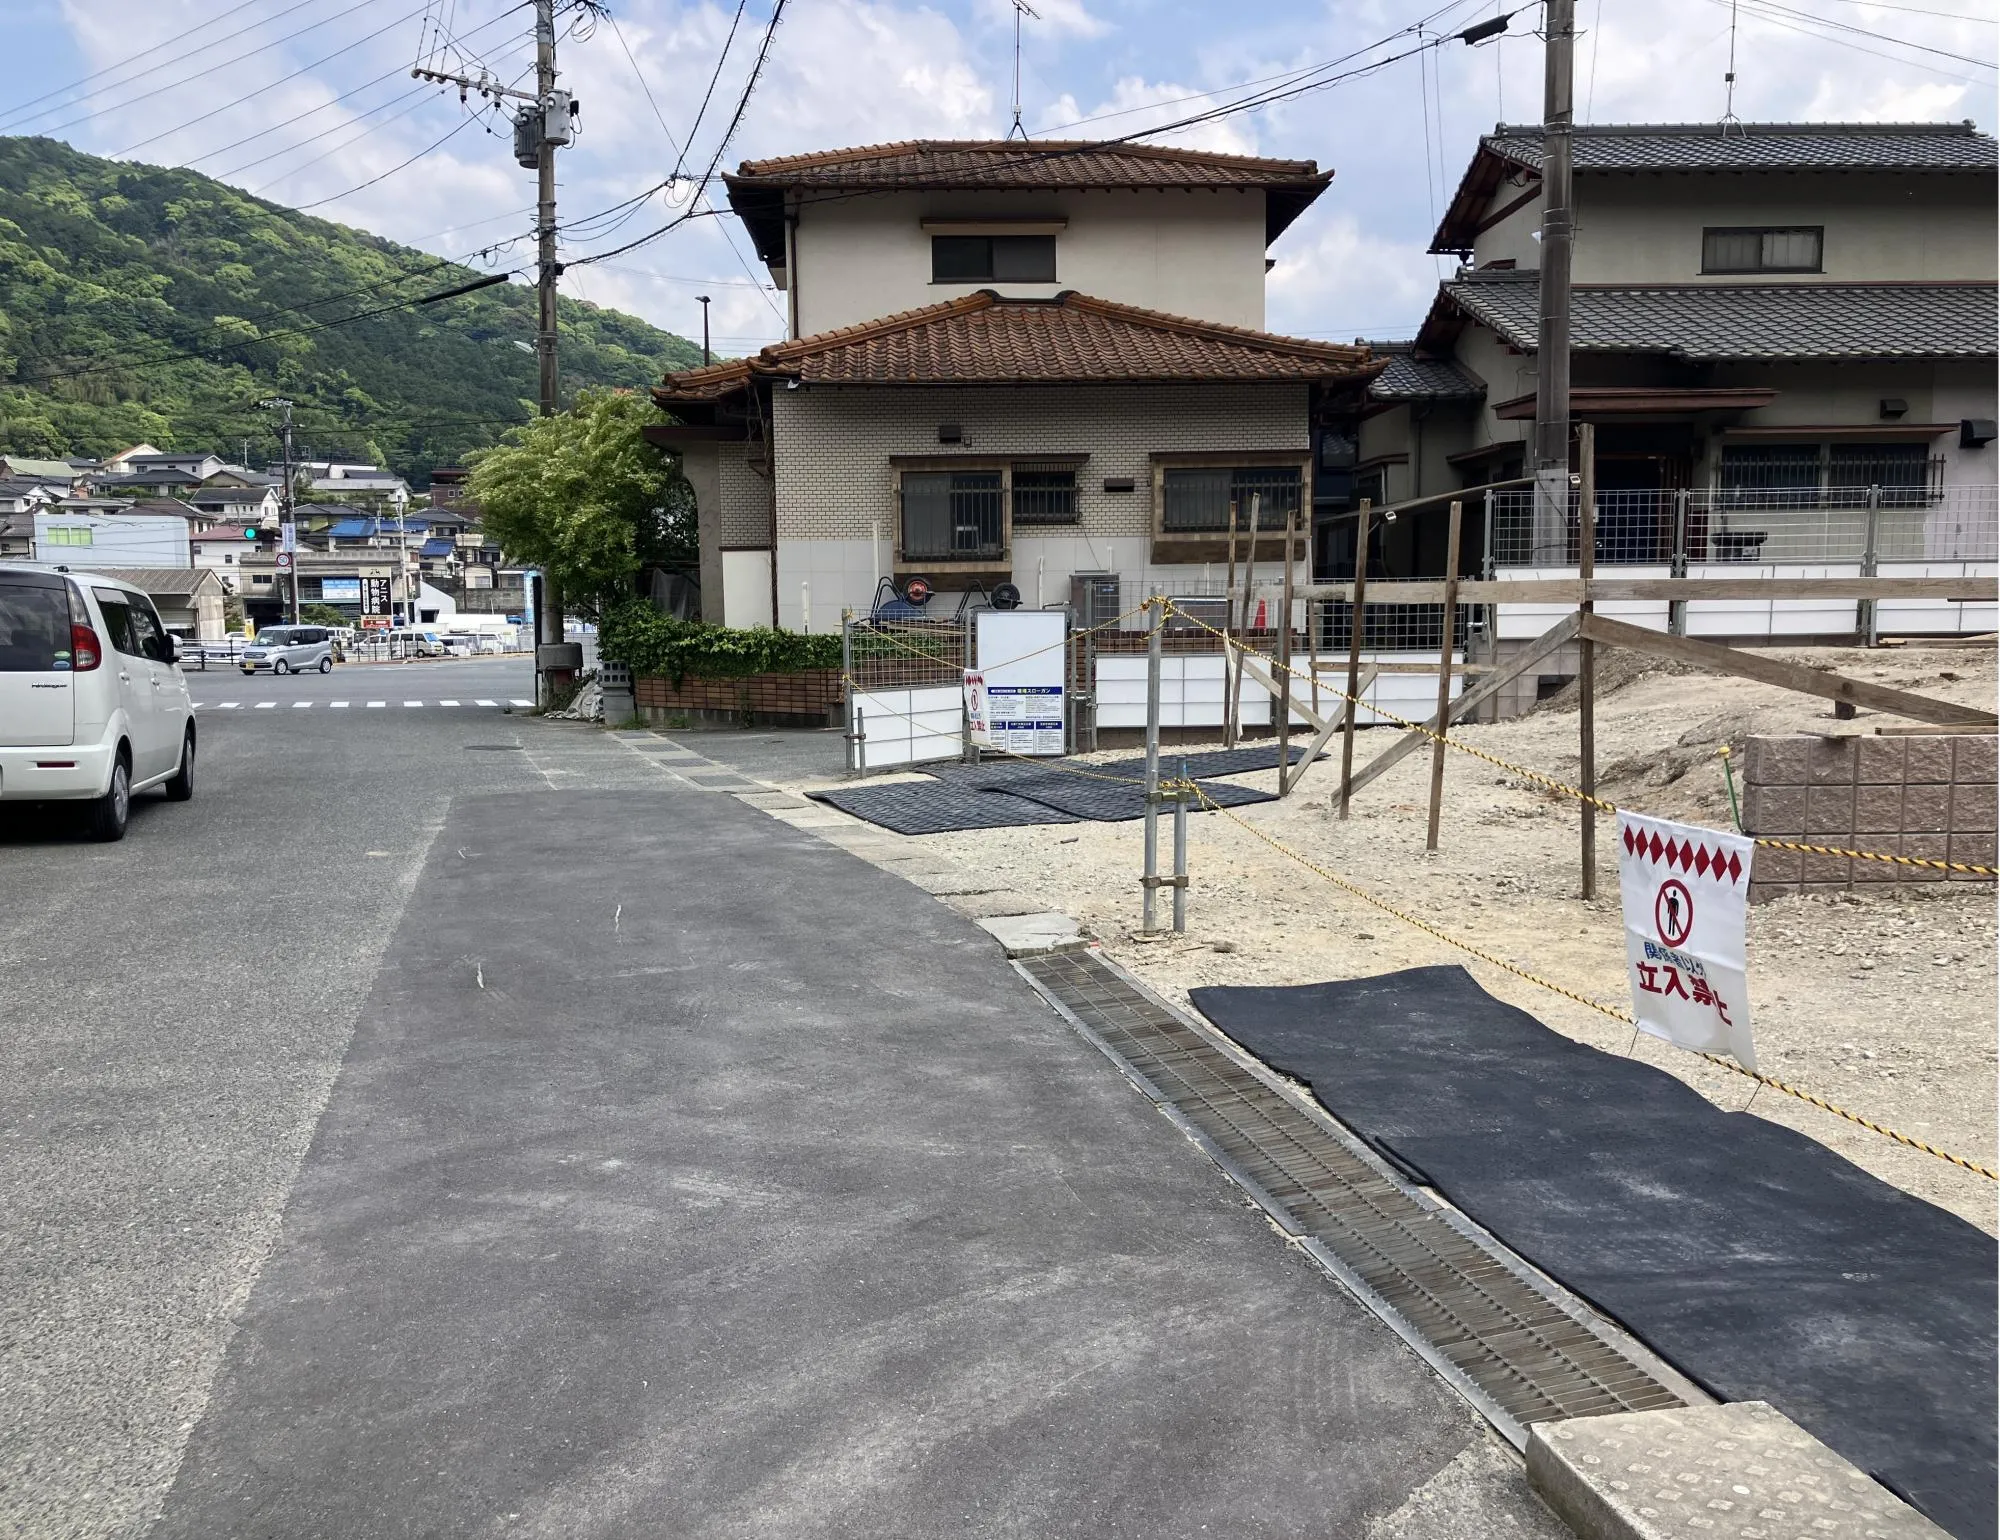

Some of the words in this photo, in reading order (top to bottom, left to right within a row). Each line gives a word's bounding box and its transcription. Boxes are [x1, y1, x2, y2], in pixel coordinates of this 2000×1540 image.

[370, 578, 380, 614] 動物病院
[380, 579, 388, 602] アニス
